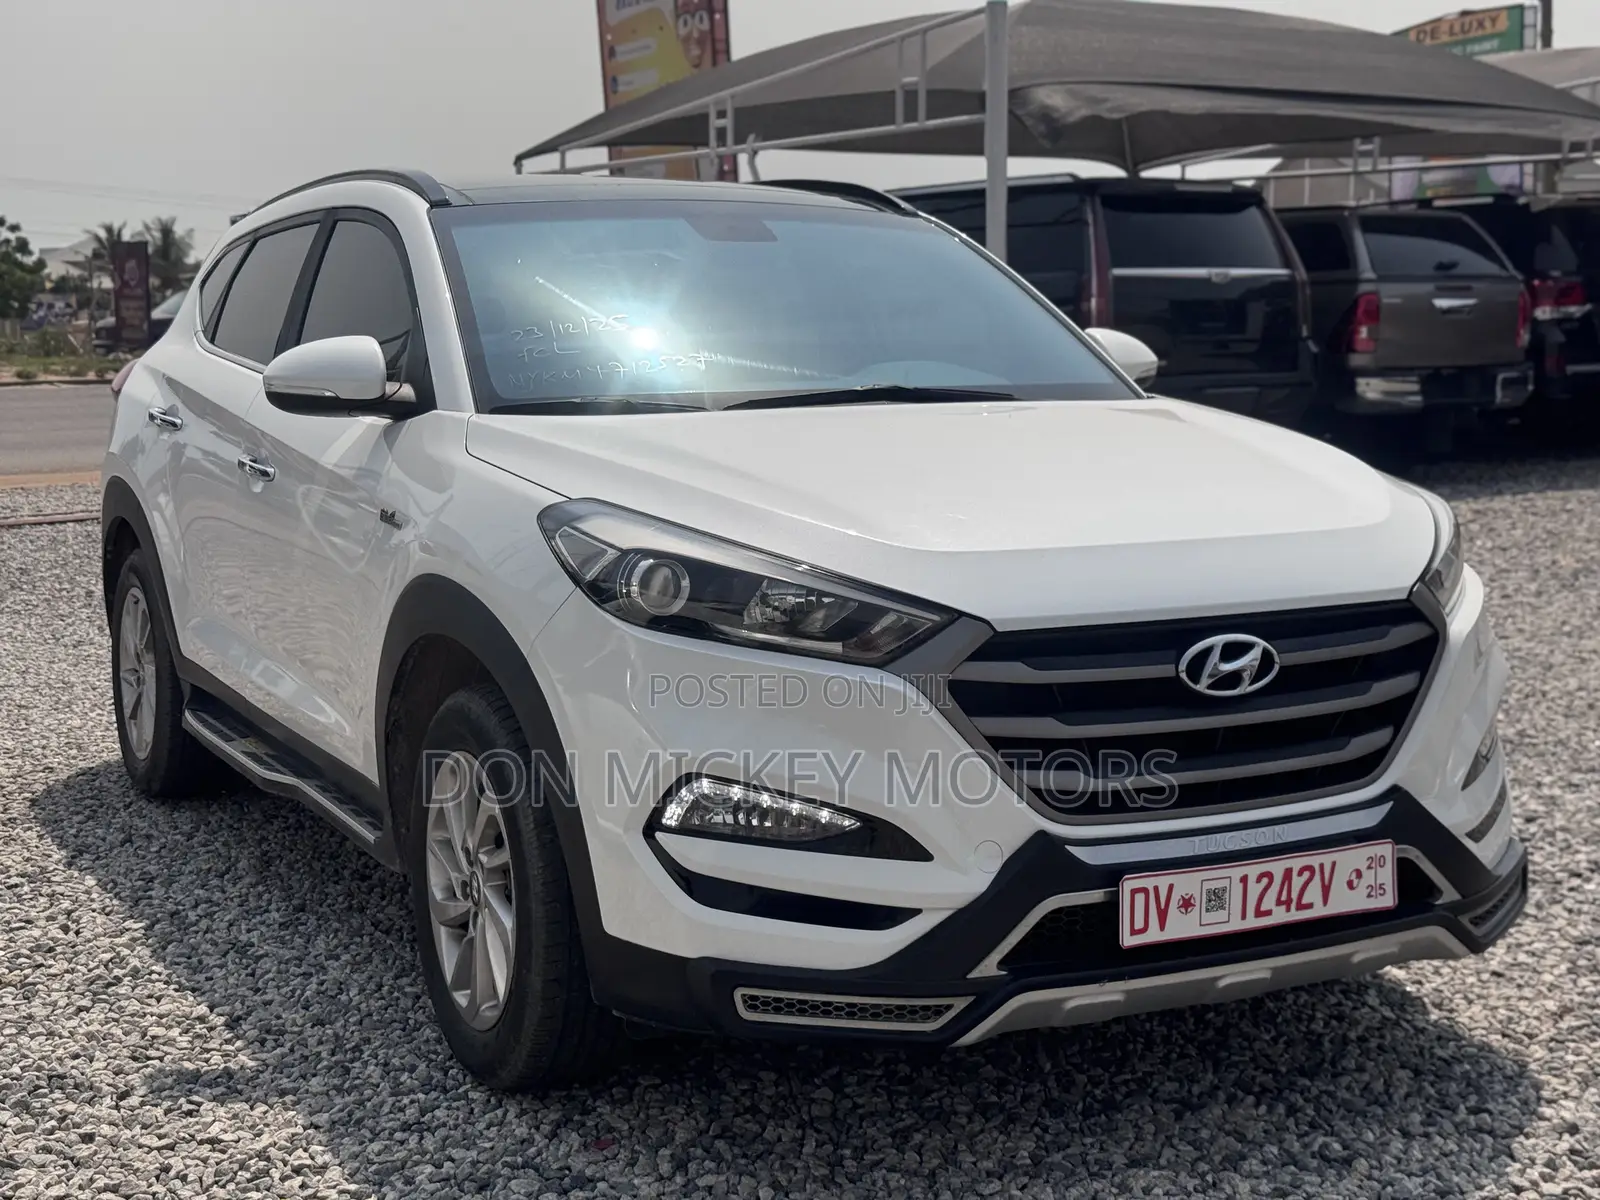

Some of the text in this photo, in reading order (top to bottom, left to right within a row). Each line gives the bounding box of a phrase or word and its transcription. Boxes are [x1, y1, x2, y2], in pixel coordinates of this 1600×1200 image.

[1415, 14, 1501, 43] DE-LUXY
[1191, 825, 1290, 855] TUCSON
[1129, 860, 1337, 937] DV 1242V
